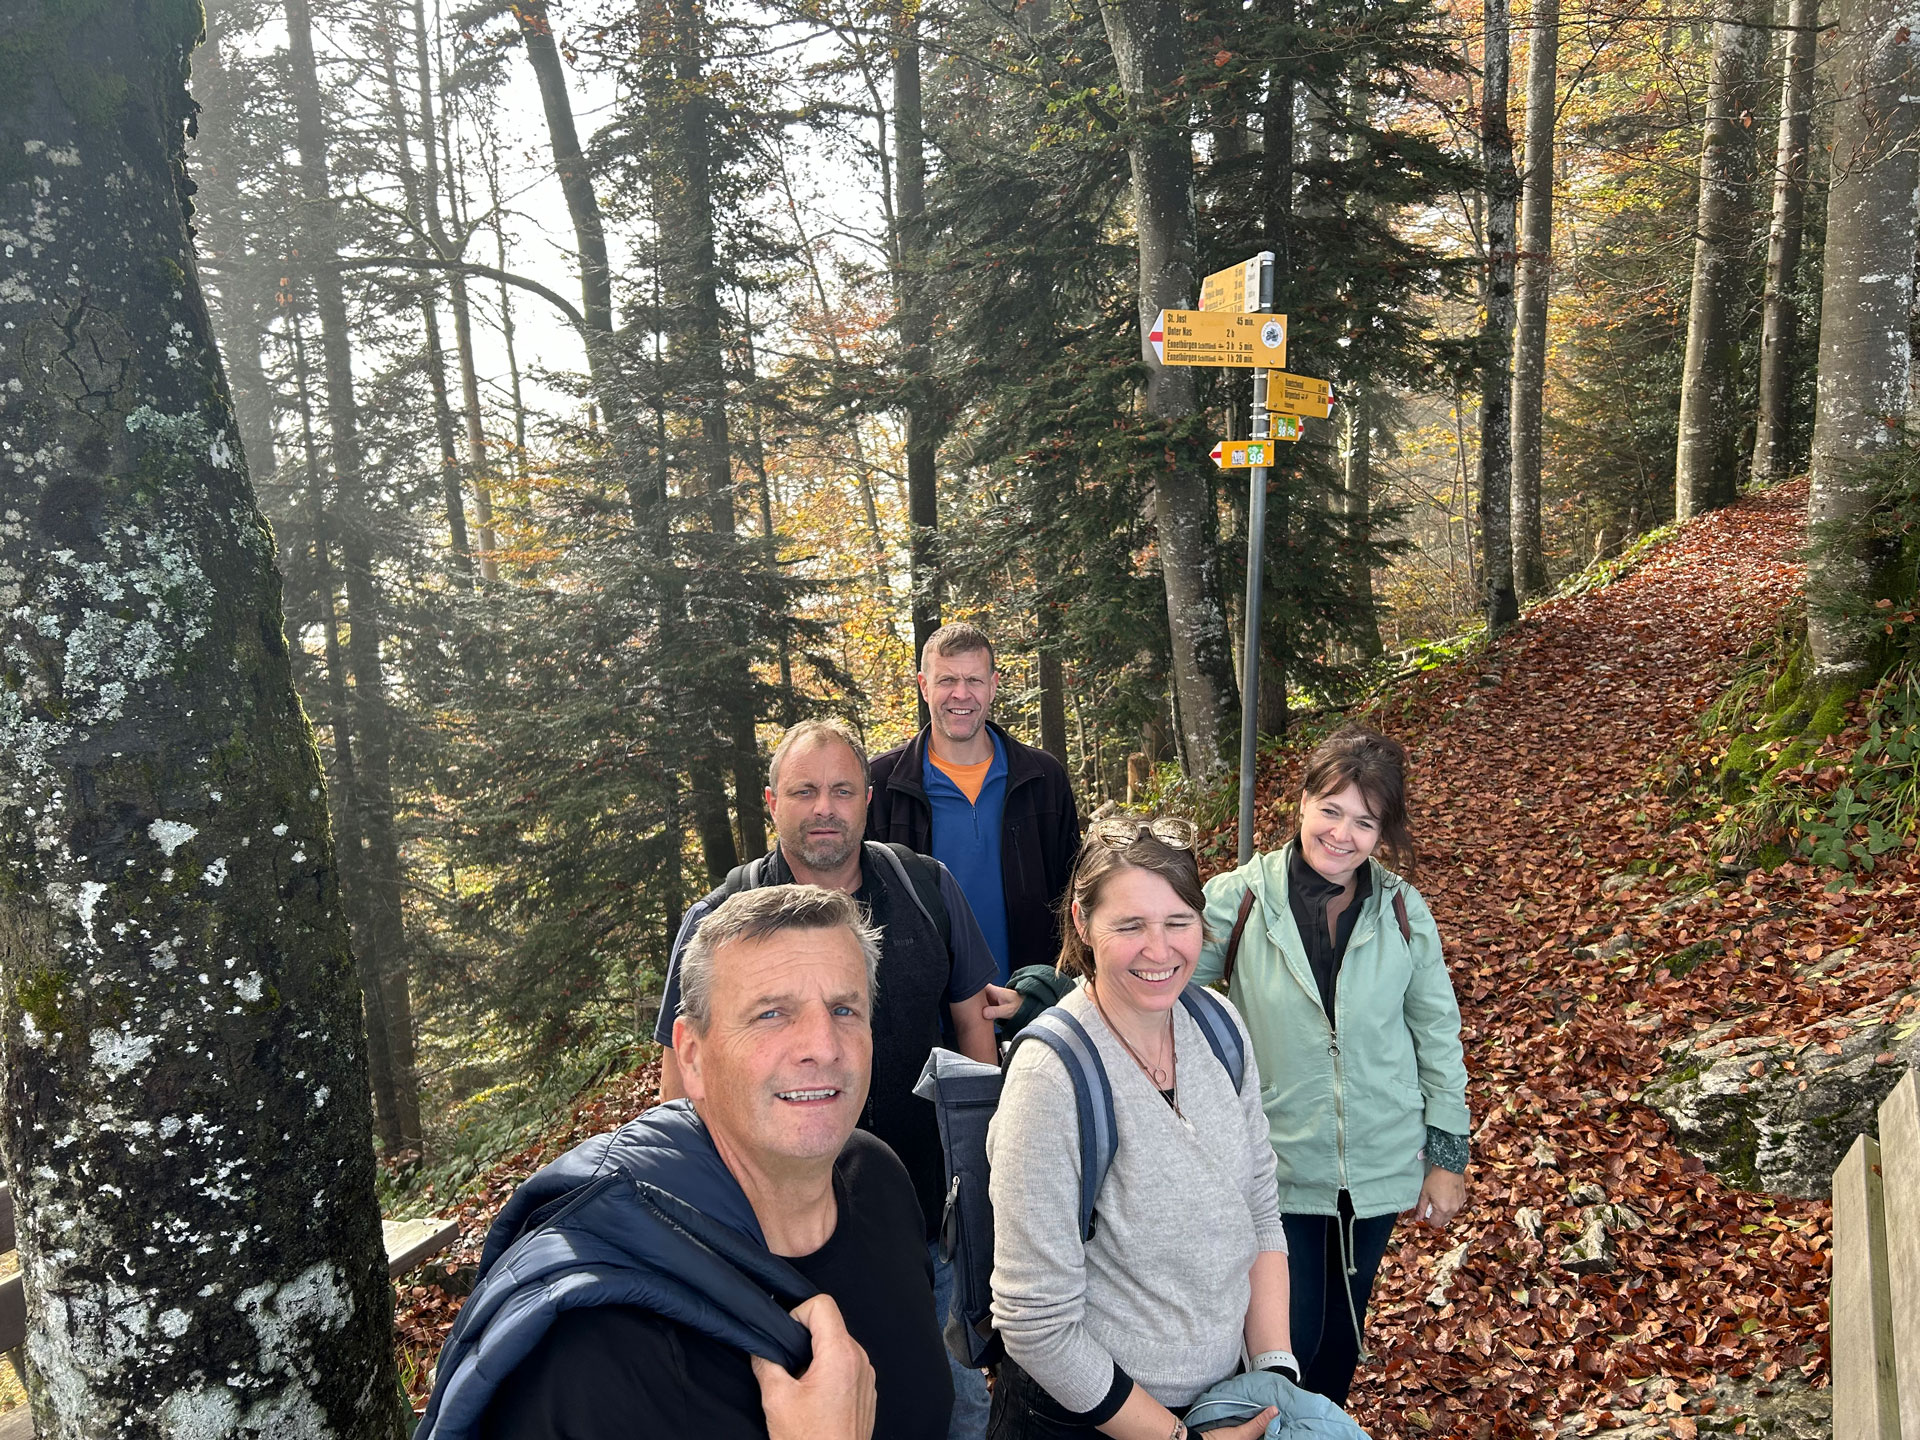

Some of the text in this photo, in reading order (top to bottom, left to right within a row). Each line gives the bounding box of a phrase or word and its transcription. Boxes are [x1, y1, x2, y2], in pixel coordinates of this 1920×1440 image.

[1167, 313, 1254, 326] St. Jost 45 min.
[1226, 328, 1230, 338] 2
[1231, 329, 1235, 338] h
[1167, 339, 1197, 351] Ennetbürgen
[1226, 341, 1230, 350] 3
[1231, 341, 1235, 350] h
[1239, 341, 1243, 351] 5
[1244, 342, 1254, 351] min.
[1167, 352, 1197, 363] Ennetbürgen
[1231, 354, 1235, 363] h
[1235, 354, 1243, 363] 20
[1243, 354, 1254, 363] min.
[1248, 452, 1264, 465] 98
